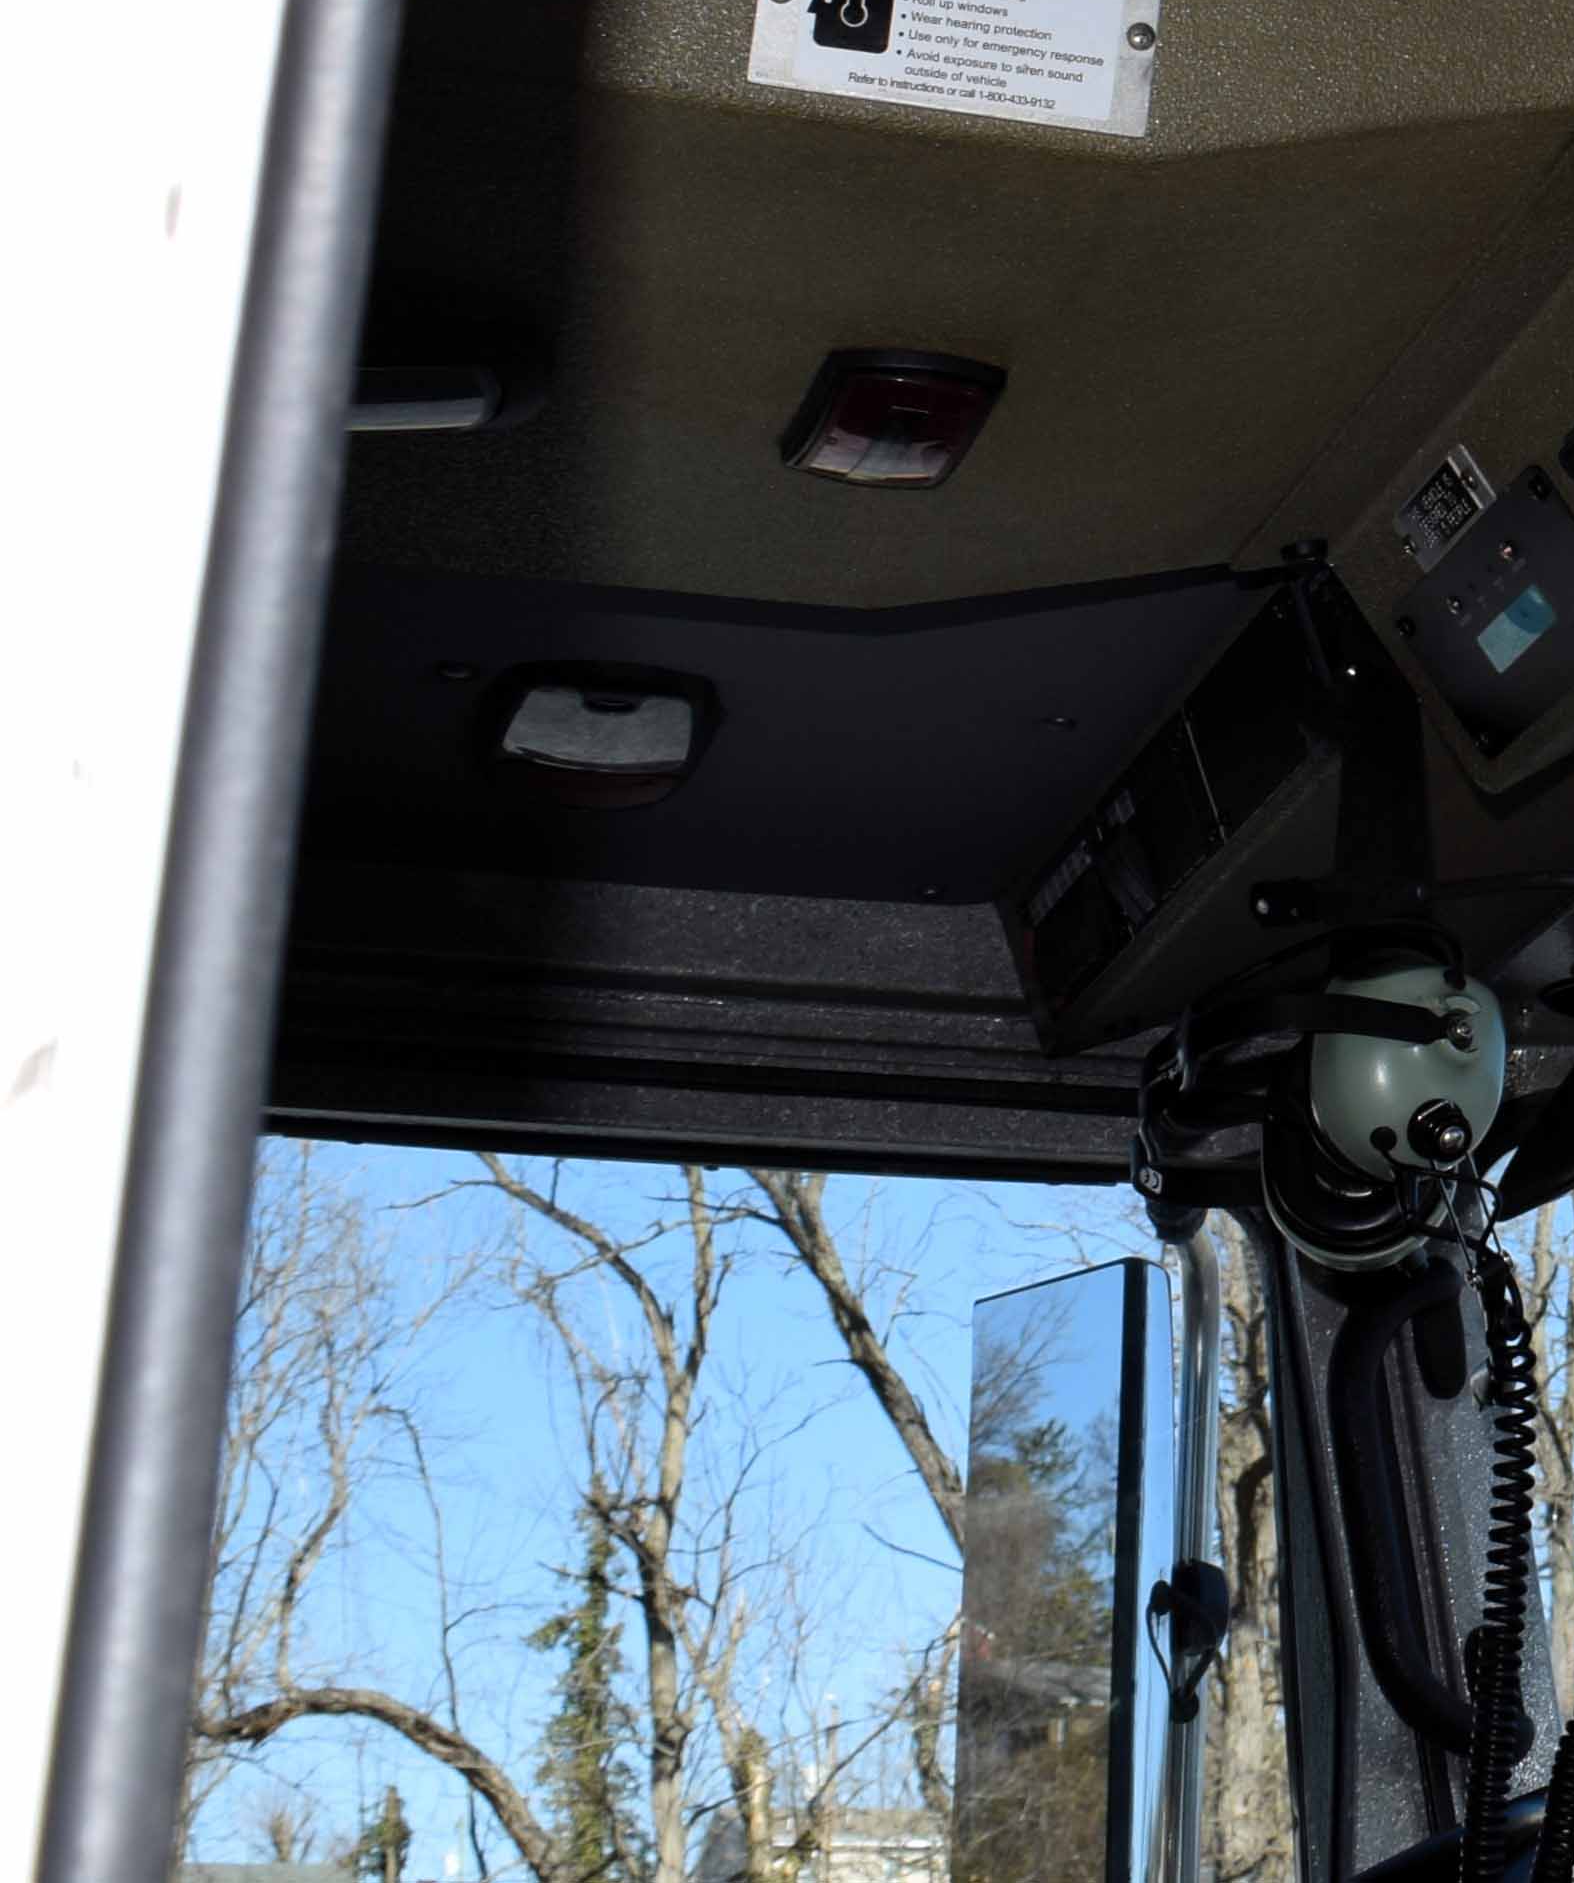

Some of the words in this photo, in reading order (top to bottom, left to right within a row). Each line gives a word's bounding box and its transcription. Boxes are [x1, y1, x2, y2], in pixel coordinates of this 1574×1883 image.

[939, 0, 954, 10] up
[957, 2, 1008, 17] windows
[911, 11, 943, 25] Wear
[945, 17, 991, 34] hearing
[993, 24, 1052, 40] protection
[908, 29, 932, 42] Use
[935, 35, 959, 48] only
[963, 37, 979, 48] for
[982, 42, 1047, 60] emergency
[1050, 51, 1104, 67] response
[904, 66, 948, 80] outside
[951, 72, 963, 82] of
[966, 75, 1007, 88] vehicle
[906, 48, 940, 62] Avoid
[943, 55, 997, 71] exposure
[1001, 62, 1013, 72] to
[1016, 64, 1044, 76] siren
[1047, 69, 1084, 83] sound
[848, 72, 875, 84] Refer
[878, 77, 888, 86] to
[890, 77, 944, 94] instructions
[946, 87, 957, 96] or
[959, 88, 976, 98] call
[979, 90, 1056, 109] 1-800-433-9132
